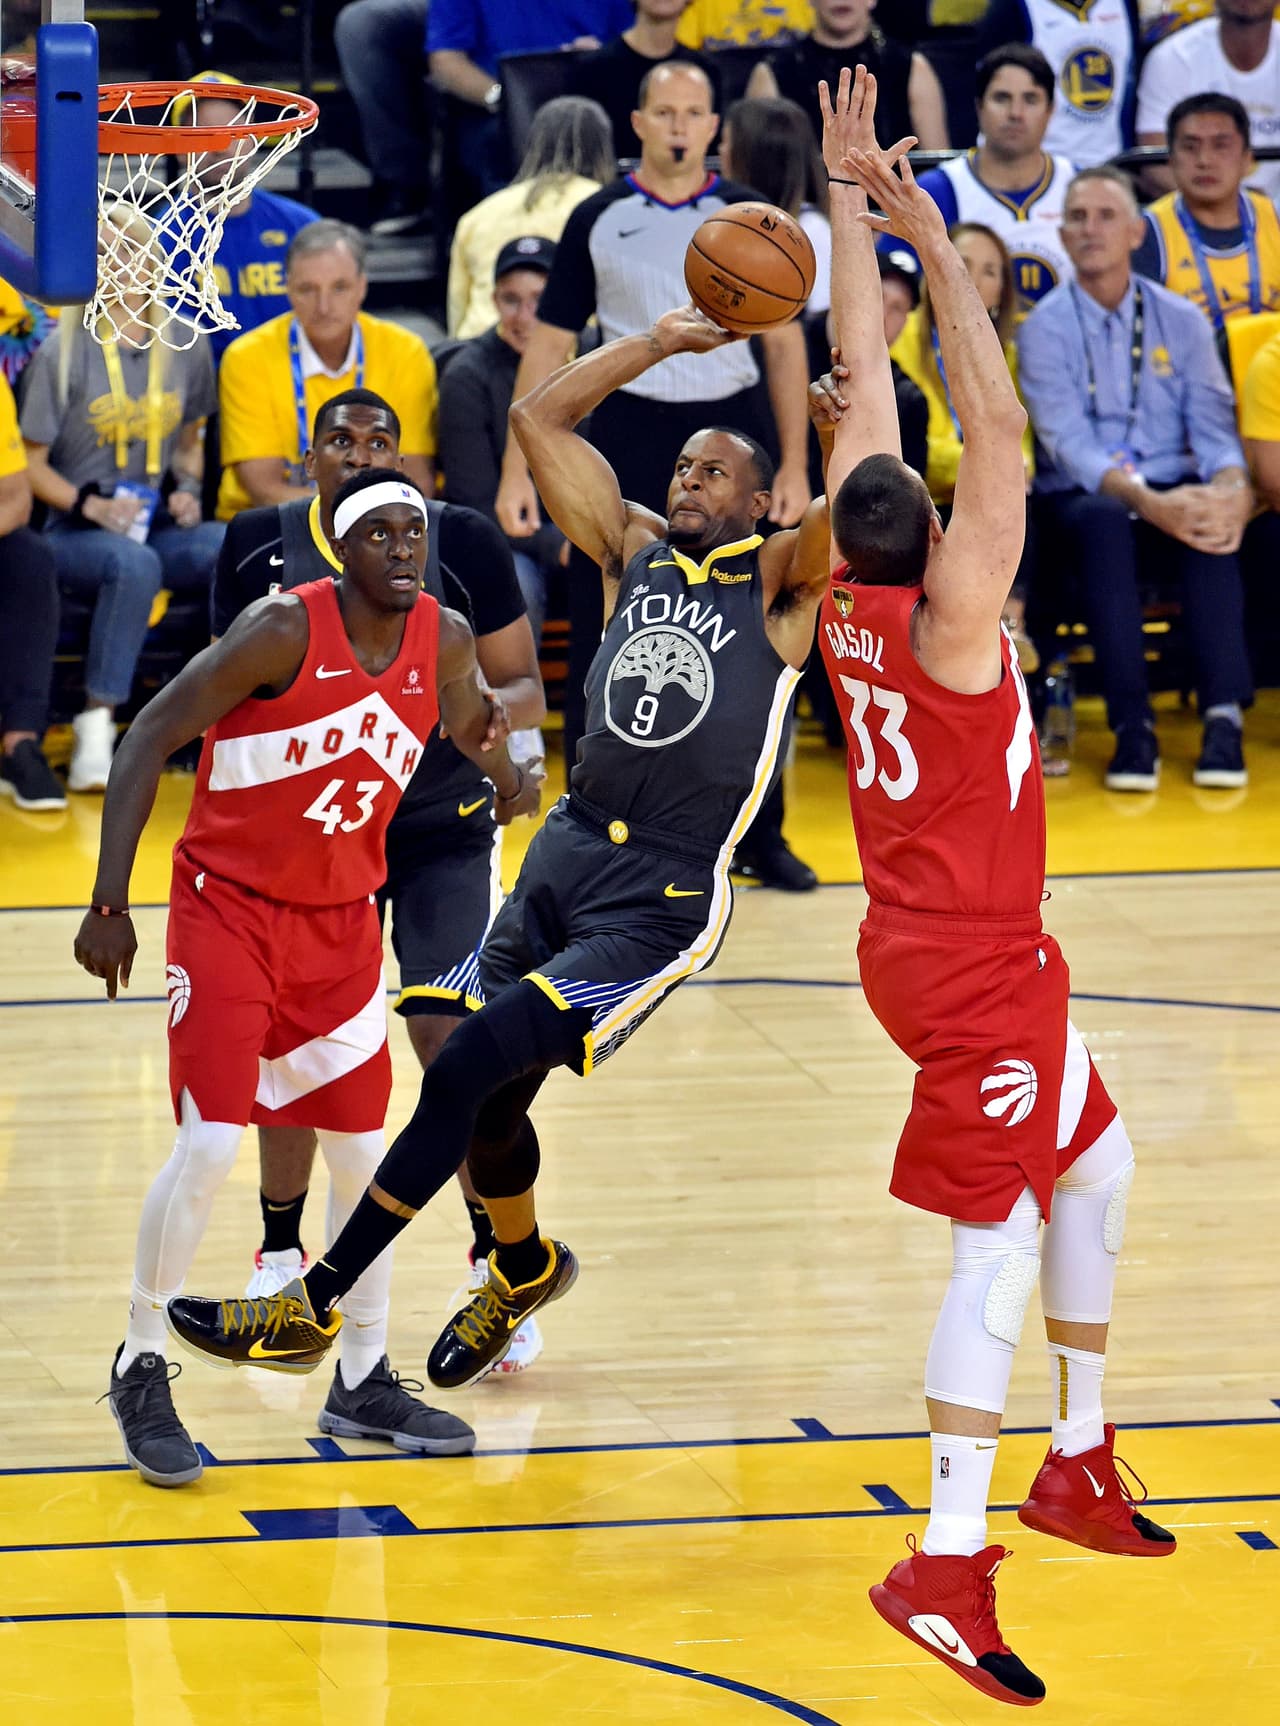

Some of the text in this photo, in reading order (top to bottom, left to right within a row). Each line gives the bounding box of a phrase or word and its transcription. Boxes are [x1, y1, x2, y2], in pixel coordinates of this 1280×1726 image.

[1021, 264, 1041, 290] 11
[711, 568, 752, 583] Rakuten
[621, 593, 737, 653] TOWN
[825, 621, 885, 673] GASOL
[631, 695, 659, 736] 9
[838, 674, 919, 801] 33
[285, 712, 418, 775] NORTH
[302, 778, 384, 835] 43
